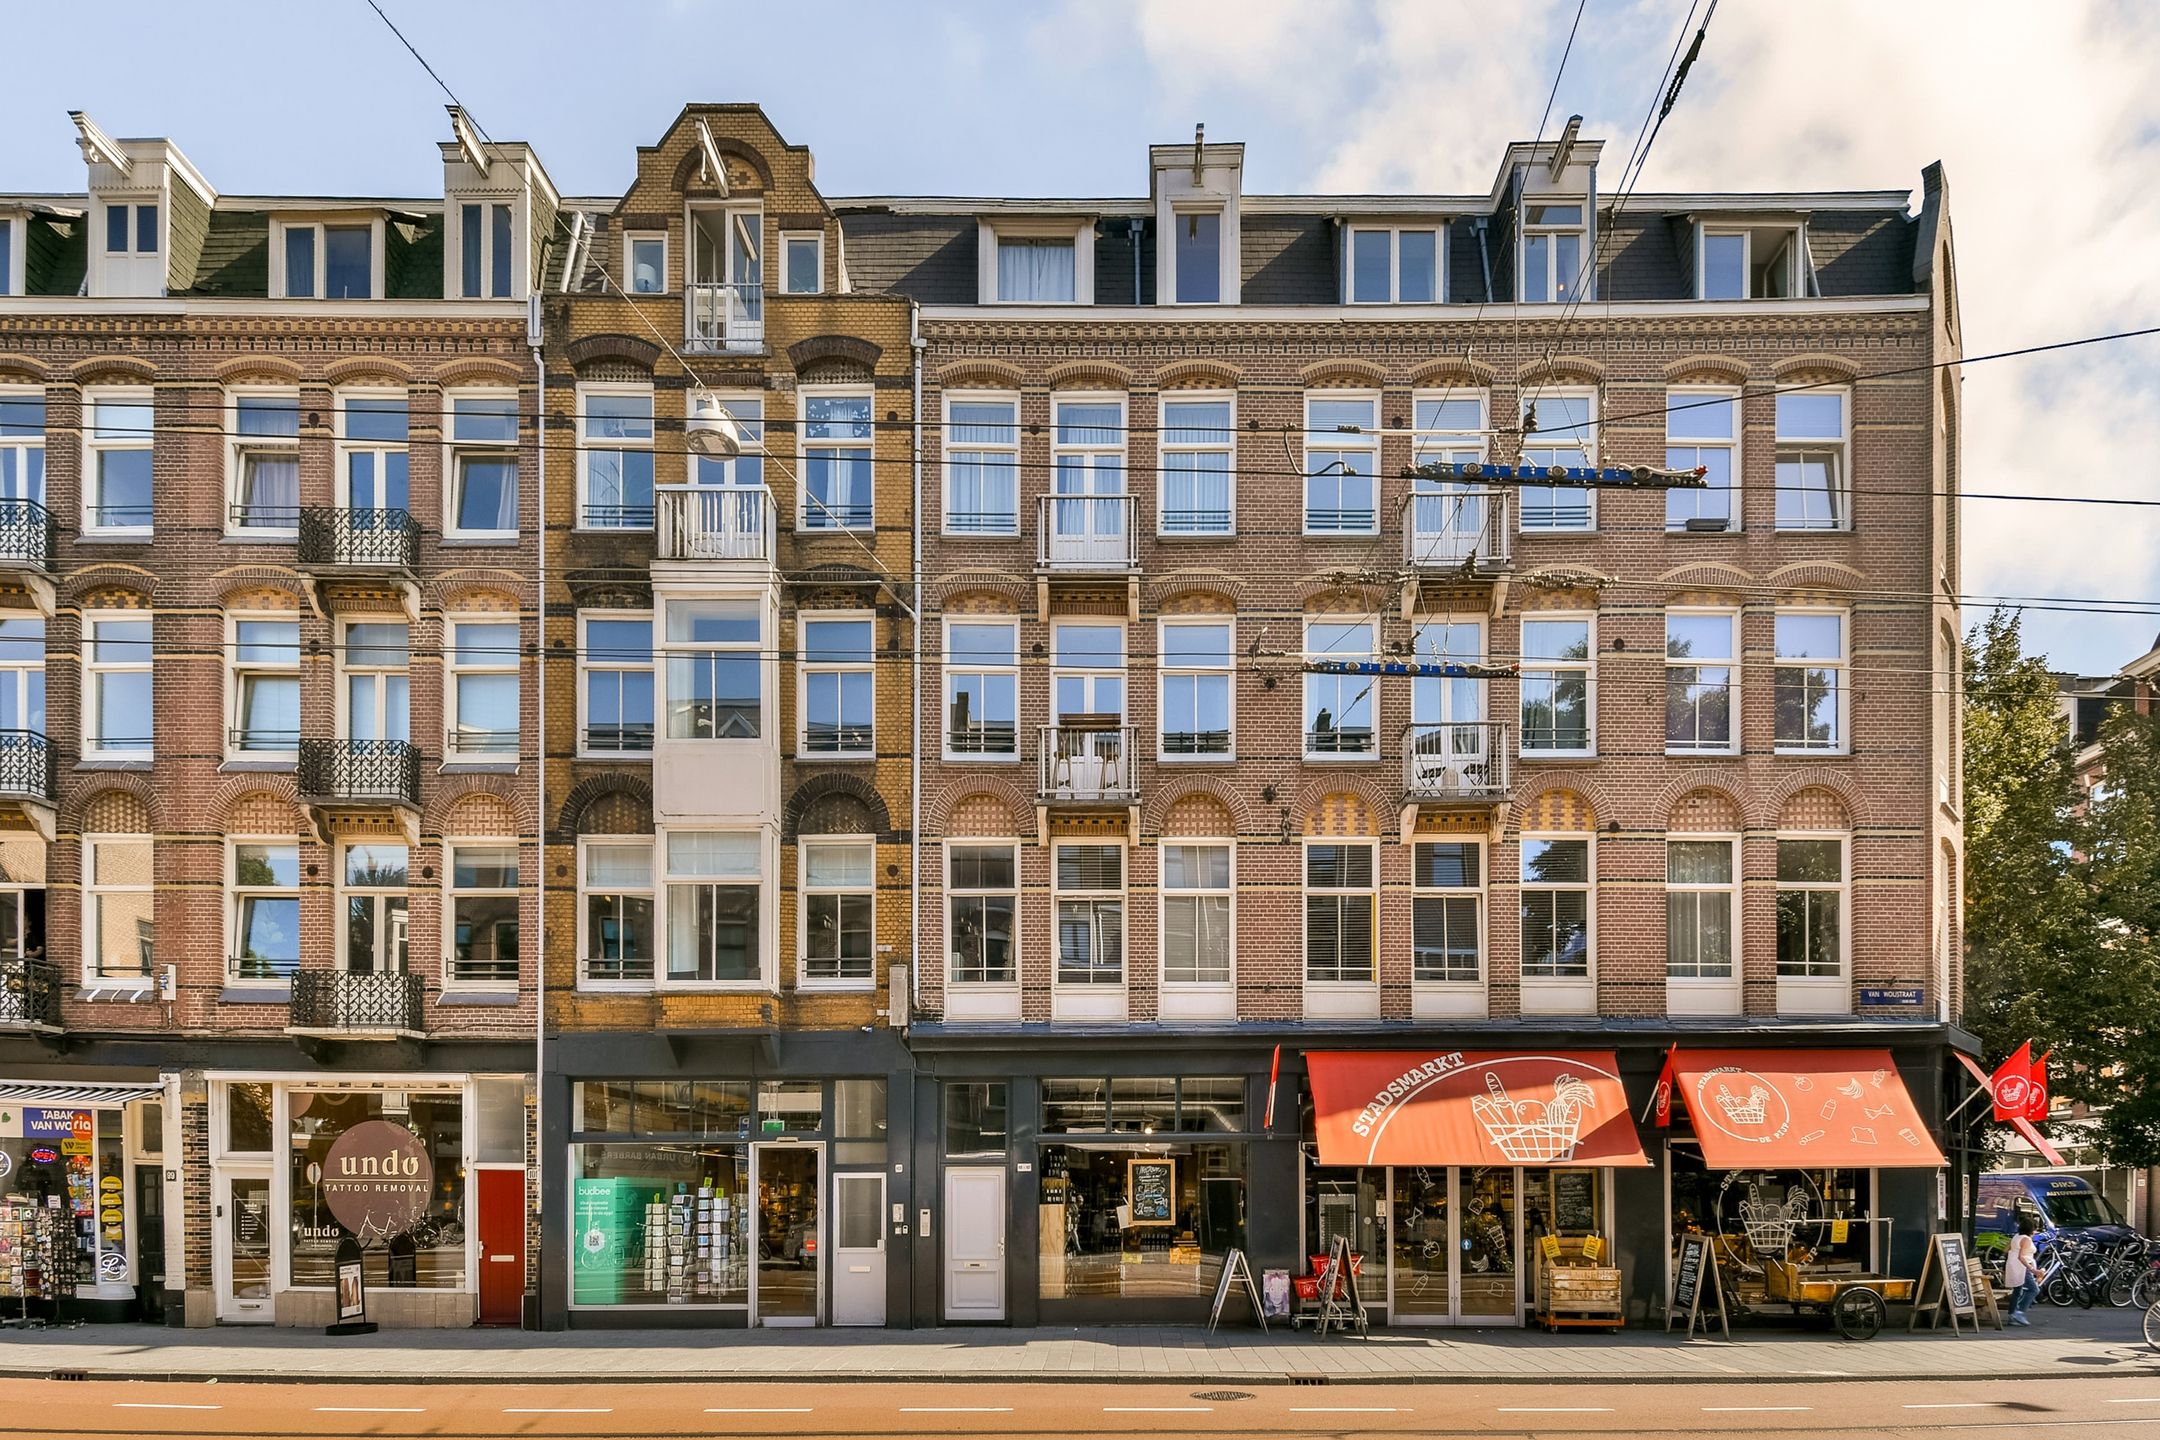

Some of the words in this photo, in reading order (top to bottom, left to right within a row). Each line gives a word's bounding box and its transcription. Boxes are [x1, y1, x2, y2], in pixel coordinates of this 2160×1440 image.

[1697, 1066, 1742, 1090] STADSMARKT
[1352, 1051, 1465, 1137] STADSMARKT
[41, 1110, 75, 1120] TABAK
[31, 1120, 52, 1131] VAN
[73, 1115, 92, 1131] ria
[1758, 1136, 1773, 1144] DE
[31, 1150, 58, 1161] OPEN
[325, 1184, 369, 1192] TATTOO
[375, 1184, 428, 1192] REMOVAL
[578, 1186, 611, 1196] budbee
